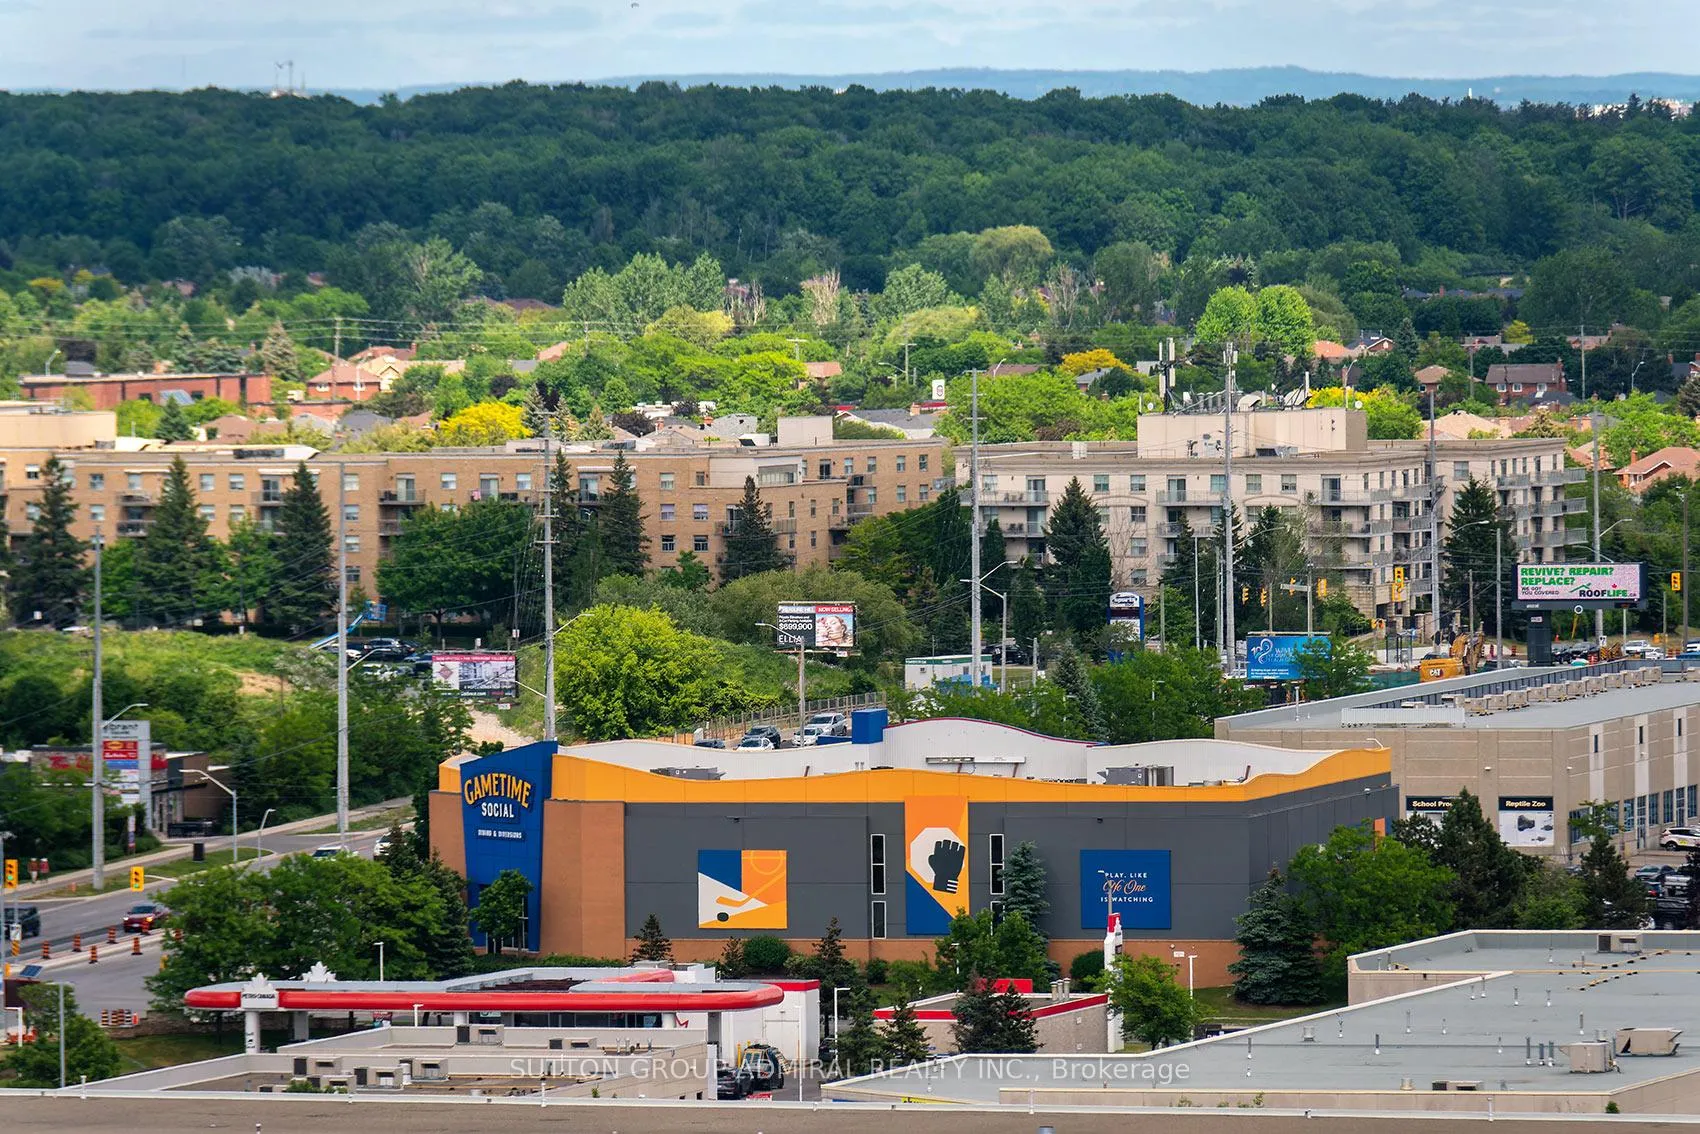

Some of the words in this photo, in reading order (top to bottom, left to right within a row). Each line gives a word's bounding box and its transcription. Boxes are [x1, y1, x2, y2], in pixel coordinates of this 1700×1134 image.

[1521, 567, 1565, 576] REVIVE?
[1568, 567, 1614, 576] REPAIR?
[1521, 577, 1575, 586] REPLACE?
[1429, 668, 1441, 677] CAT
[464, 772, 532, 808] GAMETIME
[1412, 800, 1437, 808] School
[1505, 800, 1531, 808] Reptile
[481, 802, 515, 818] SOCIAL
[1123, 879, 1147, 895] One
